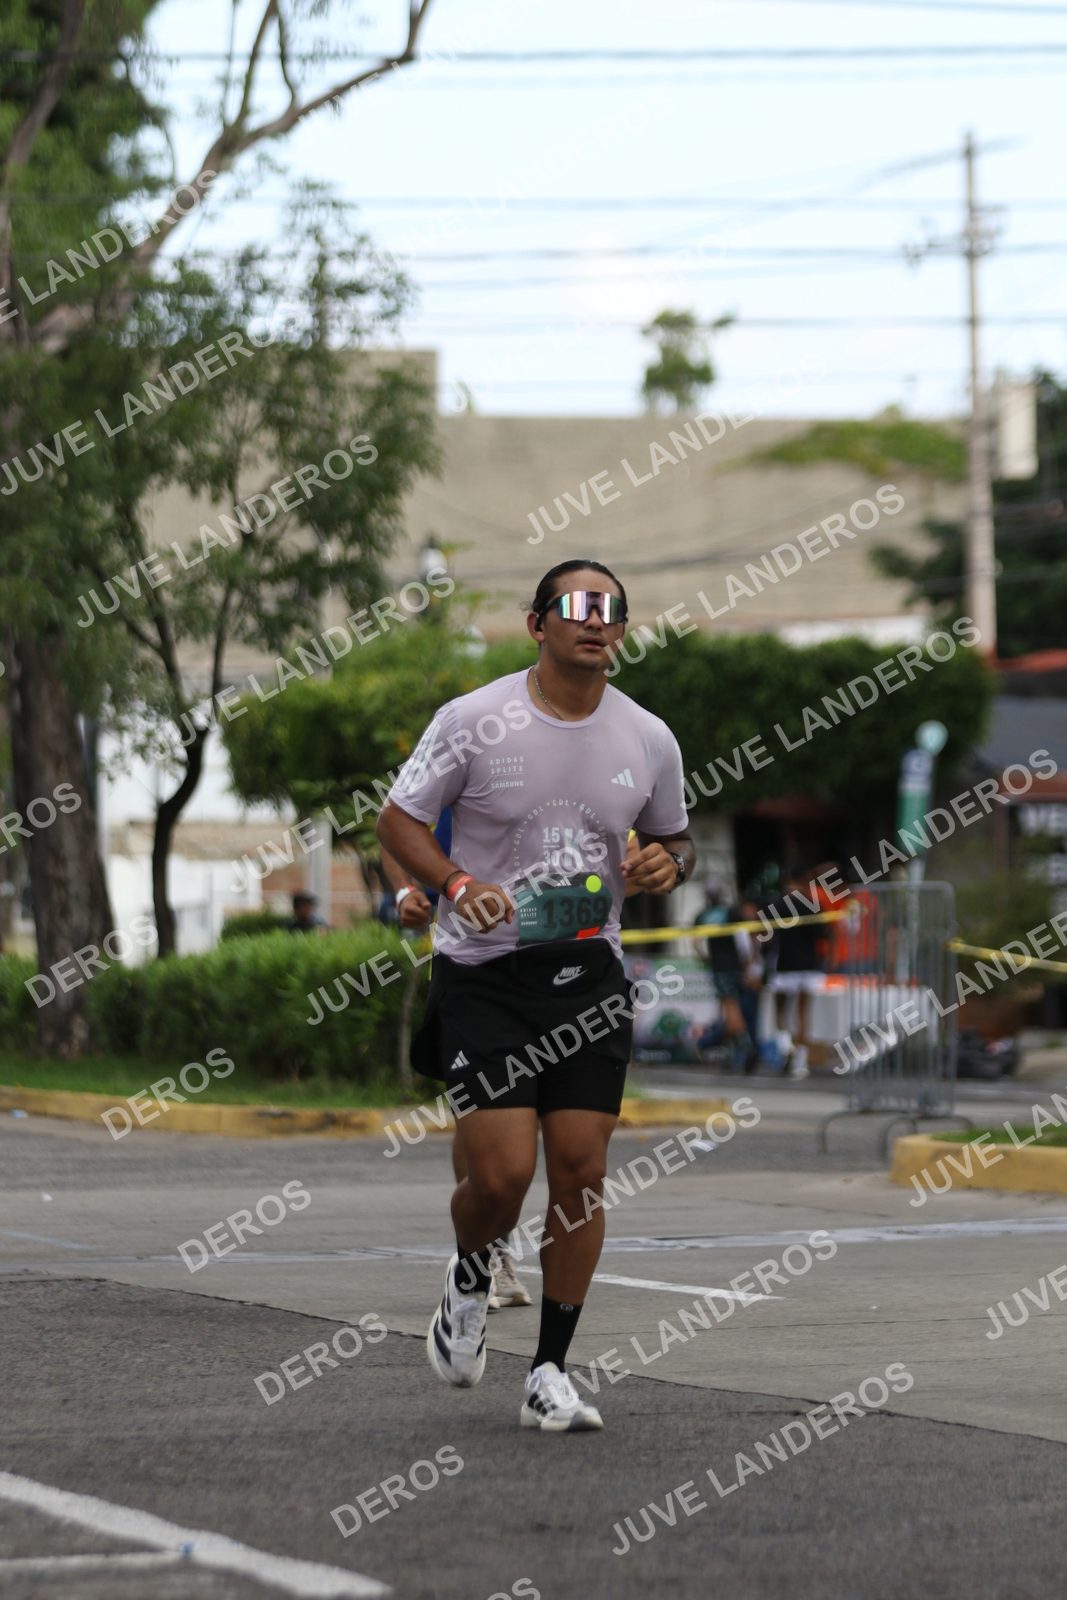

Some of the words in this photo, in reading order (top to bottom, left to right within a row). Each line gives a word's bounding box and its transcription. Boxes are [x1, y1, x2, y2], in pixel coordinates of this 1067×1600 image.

[490, 756, 524, 765] ADIDAS
[543, 826, 561, 843] 15
[543, 896, 608, 929] 1369
[560, 966, 582, 977] NIKE
